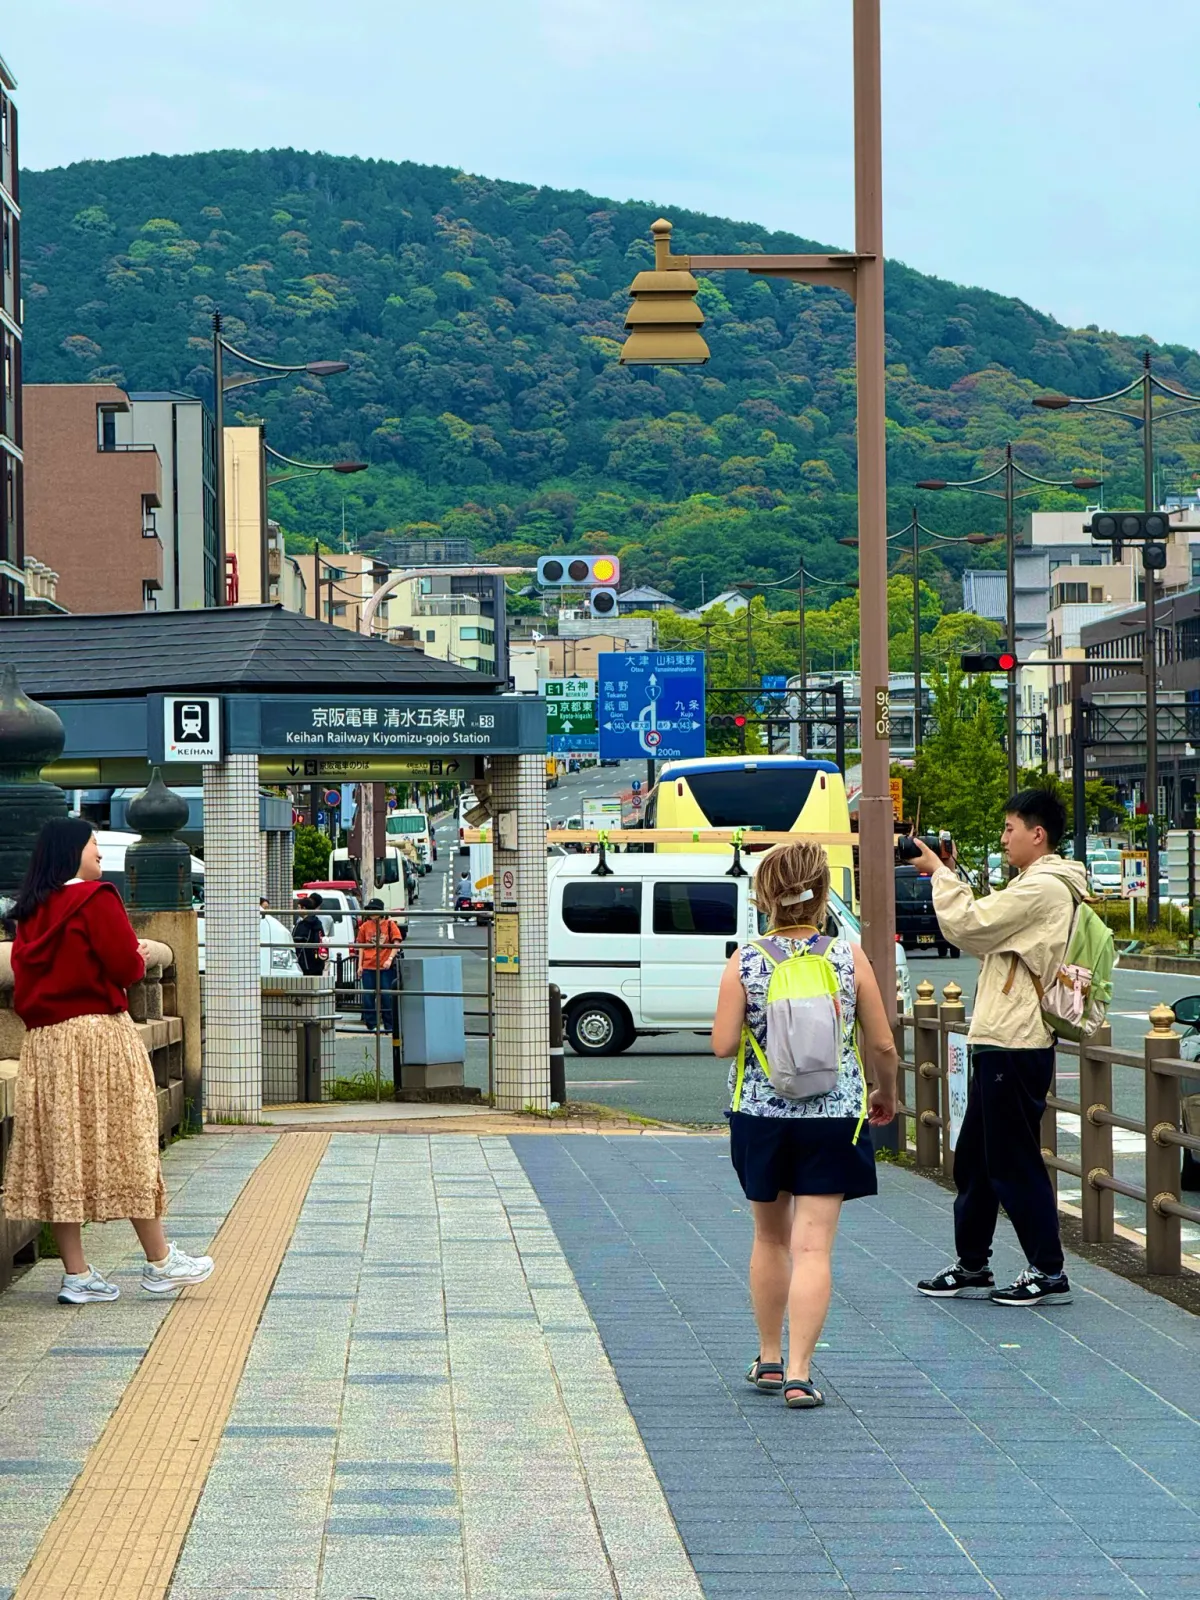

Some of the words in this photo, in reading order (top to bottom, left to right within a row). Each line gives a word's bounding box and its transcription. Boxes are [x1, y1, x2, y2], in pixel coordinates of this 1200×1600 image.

[625, 655, 649, 666] 大津
[656, 655, 695, 666] 山科東野
[547, 684, 561, 694] E1
[565, 681, 589, 691] 名神
[603, 680, 629, 692] 高野
[650, 687, 656, 697] 1
[559, 701, 593, 712] 京都東
[604, 700, 629, 711] 祇園
[674, 700, 700, 711] 九条
[311, 707, 378, 728] 京阪電車
[383, 707, 466, 728] 清水五条駅
[881, 706, 889, 720] 2
[480, 715, 494, 728] 38
[286, 731, 324, 743] Keihan
[327, 731, 370, 746] Railway
[373, 731, 450, 746] Kiyomizu-gojo
[452, 732, 491, 743] Station
[657, 748, 681, 756] 200m
